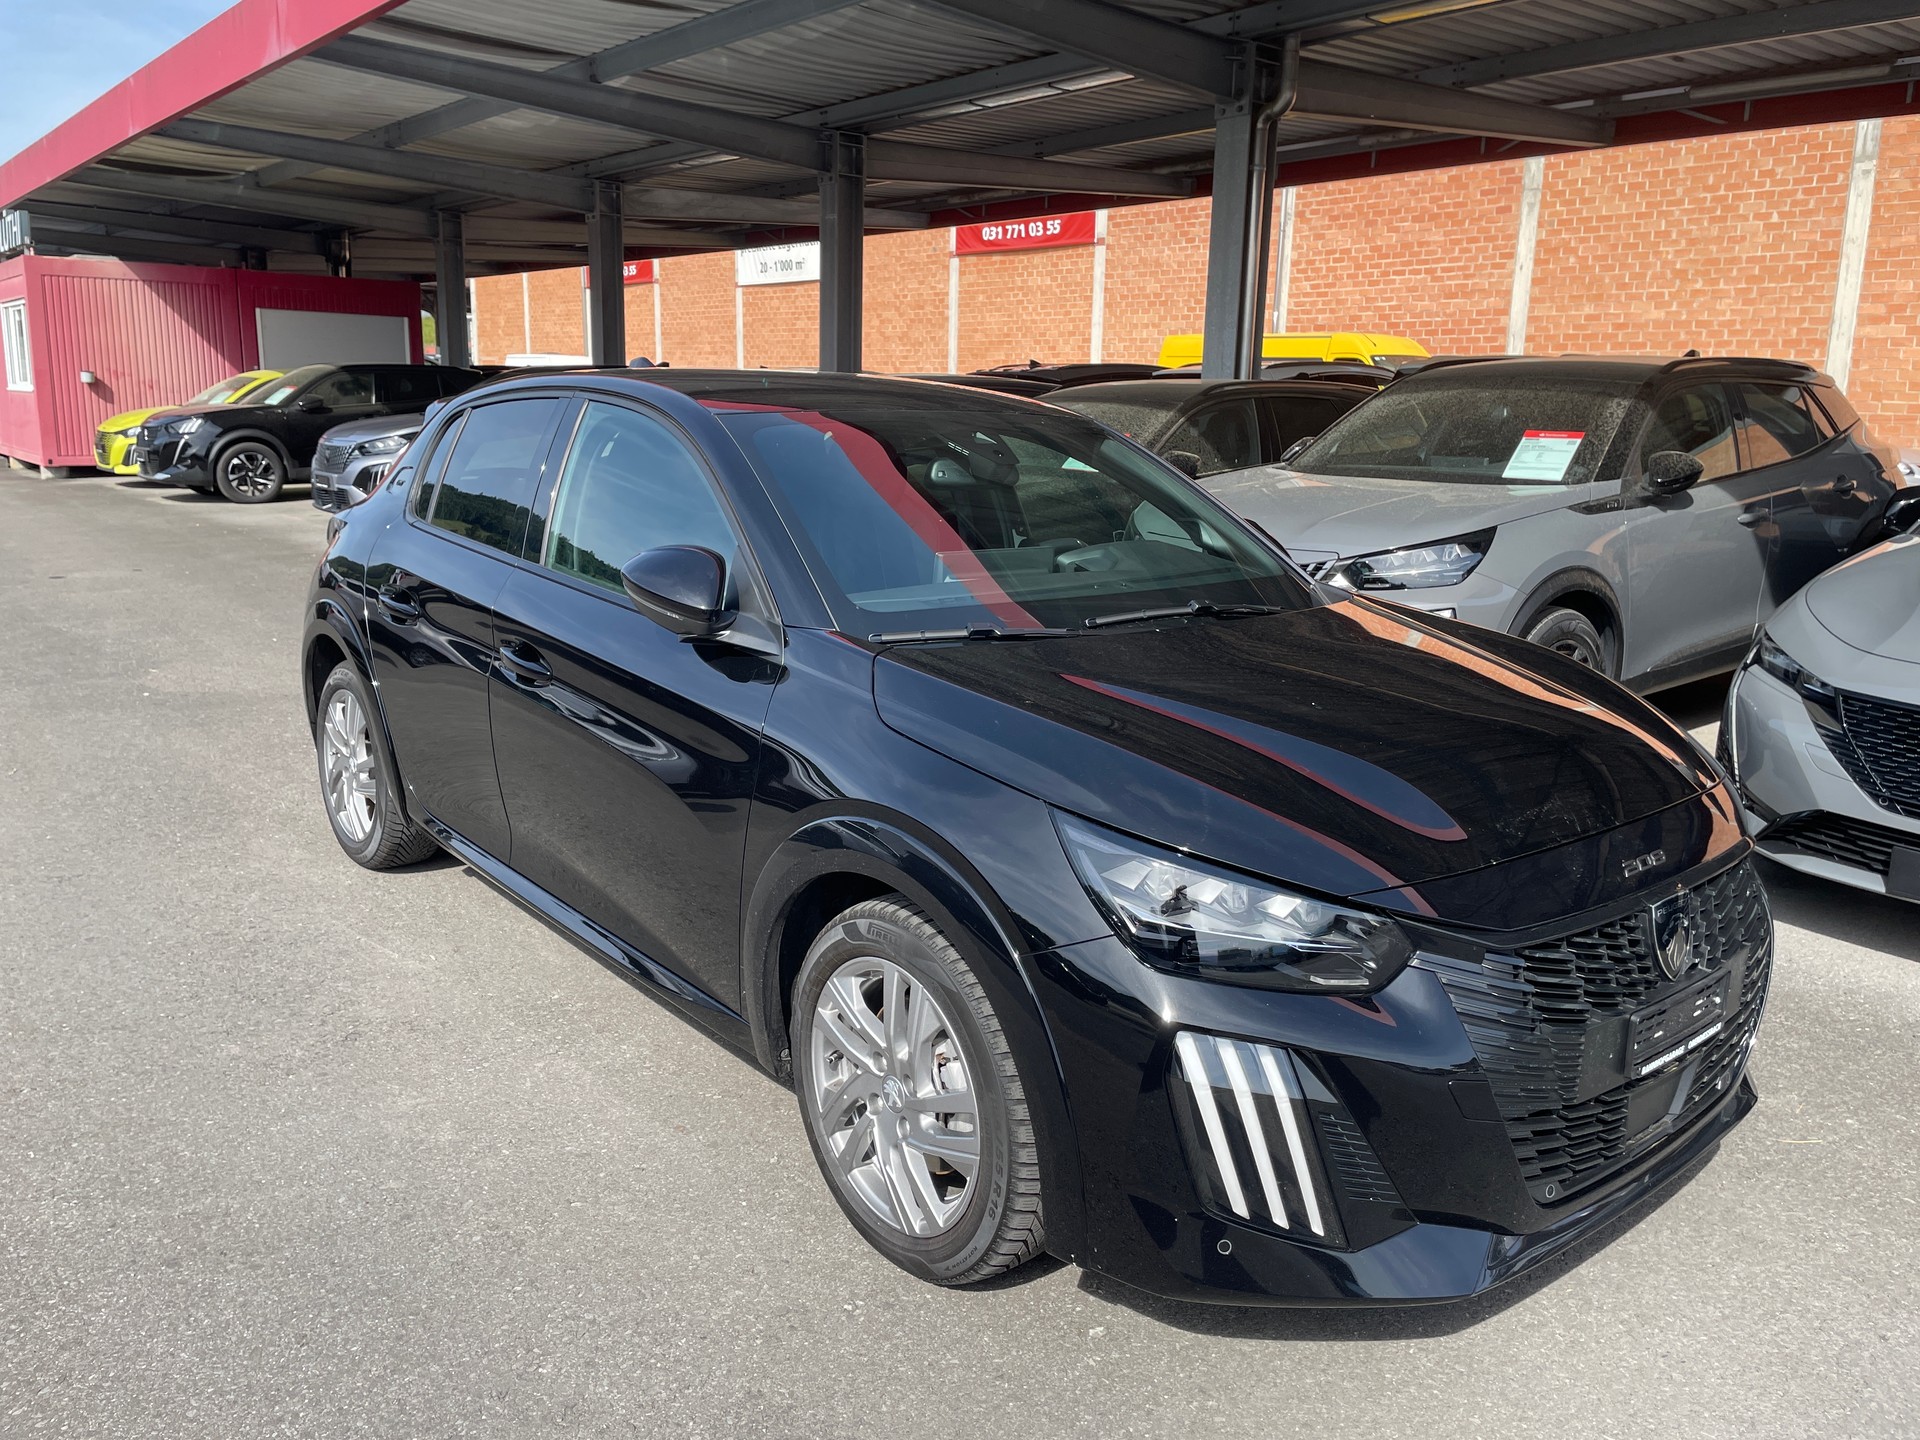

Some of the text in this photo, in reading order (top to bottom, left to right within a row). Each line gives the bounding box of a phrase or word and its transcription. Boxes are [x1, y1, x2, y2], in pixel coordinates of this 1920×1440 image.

[982, 219, 1062, 241] 031 771 03 55
[760, 261, 768, 273] 20
[774, 259, 793, 272] 1'000
[1621, 848, 1666, 878] 208
[867, 922, 901, 947] PIRELL
[951, 1245, 978, 1269] ROTATION
